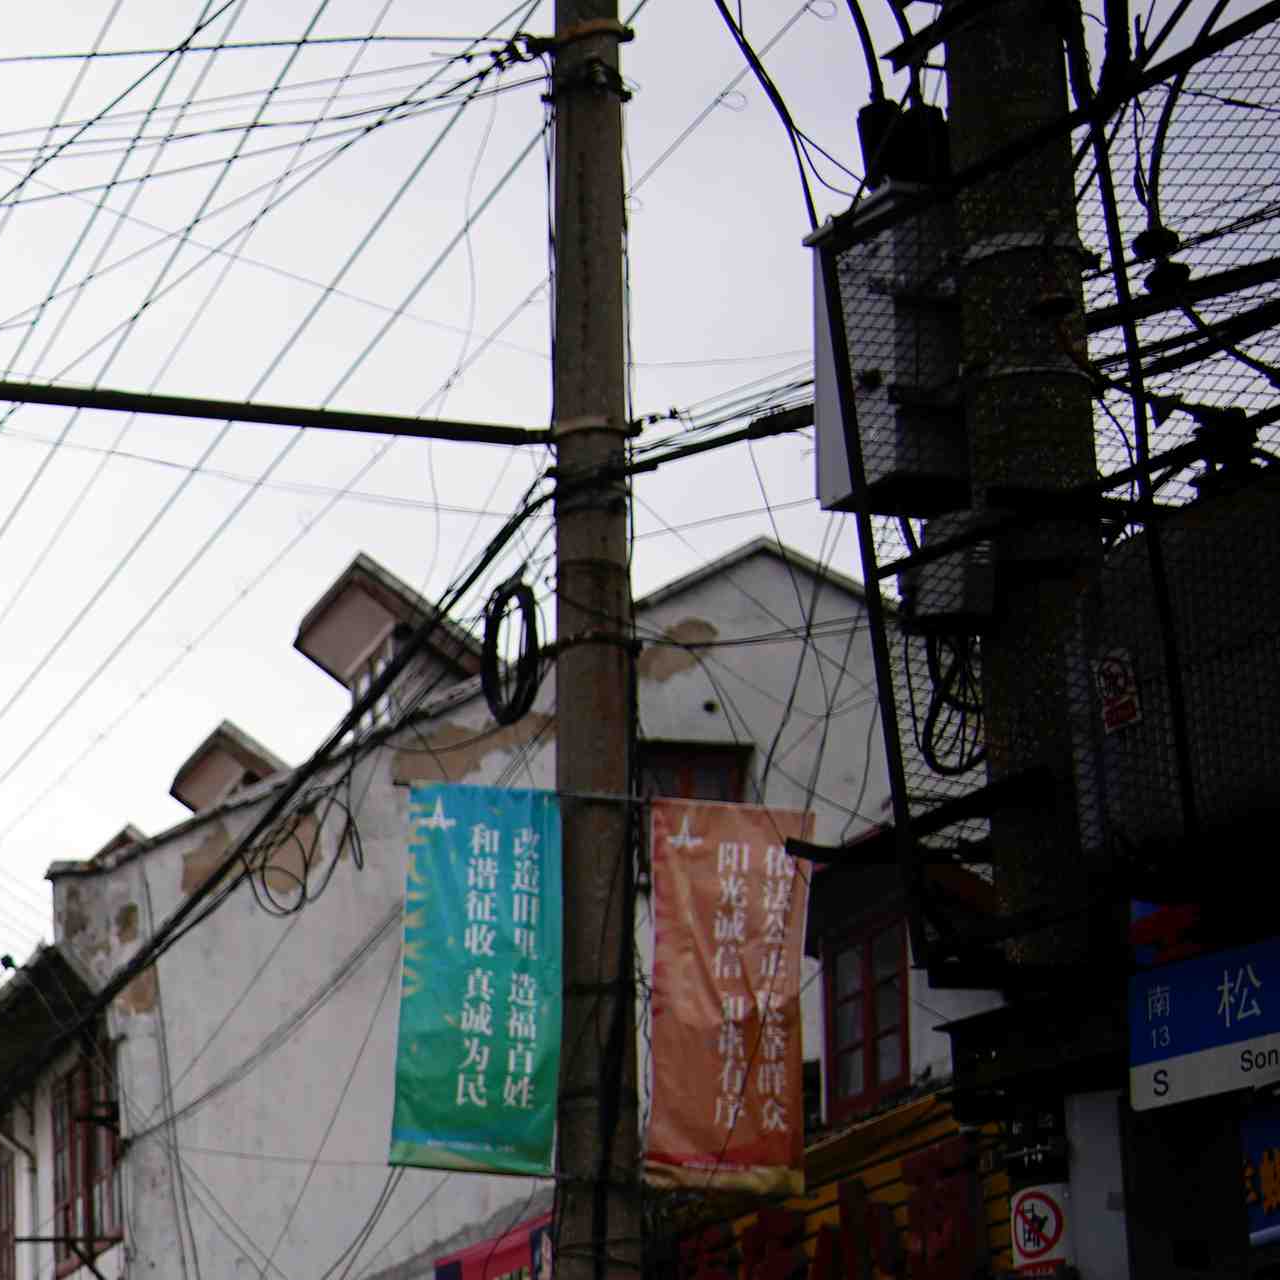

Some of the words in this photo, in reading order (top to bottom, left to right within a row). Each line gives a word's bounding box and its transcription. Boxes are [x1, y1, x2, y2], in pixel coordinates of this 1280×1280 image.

[464, 821, 500, 957] 和谐征收
[1146, 984, 1173, 1022] 南
[1216, 963, 1262, 1028] 松
[455, 966, 496, 1107] 真诚为民
[503, 971, 537, 1109] 造福百姓
[1152, 1024, 1171, 1049] 13
[1153, 1069, 1169, 1096] S
